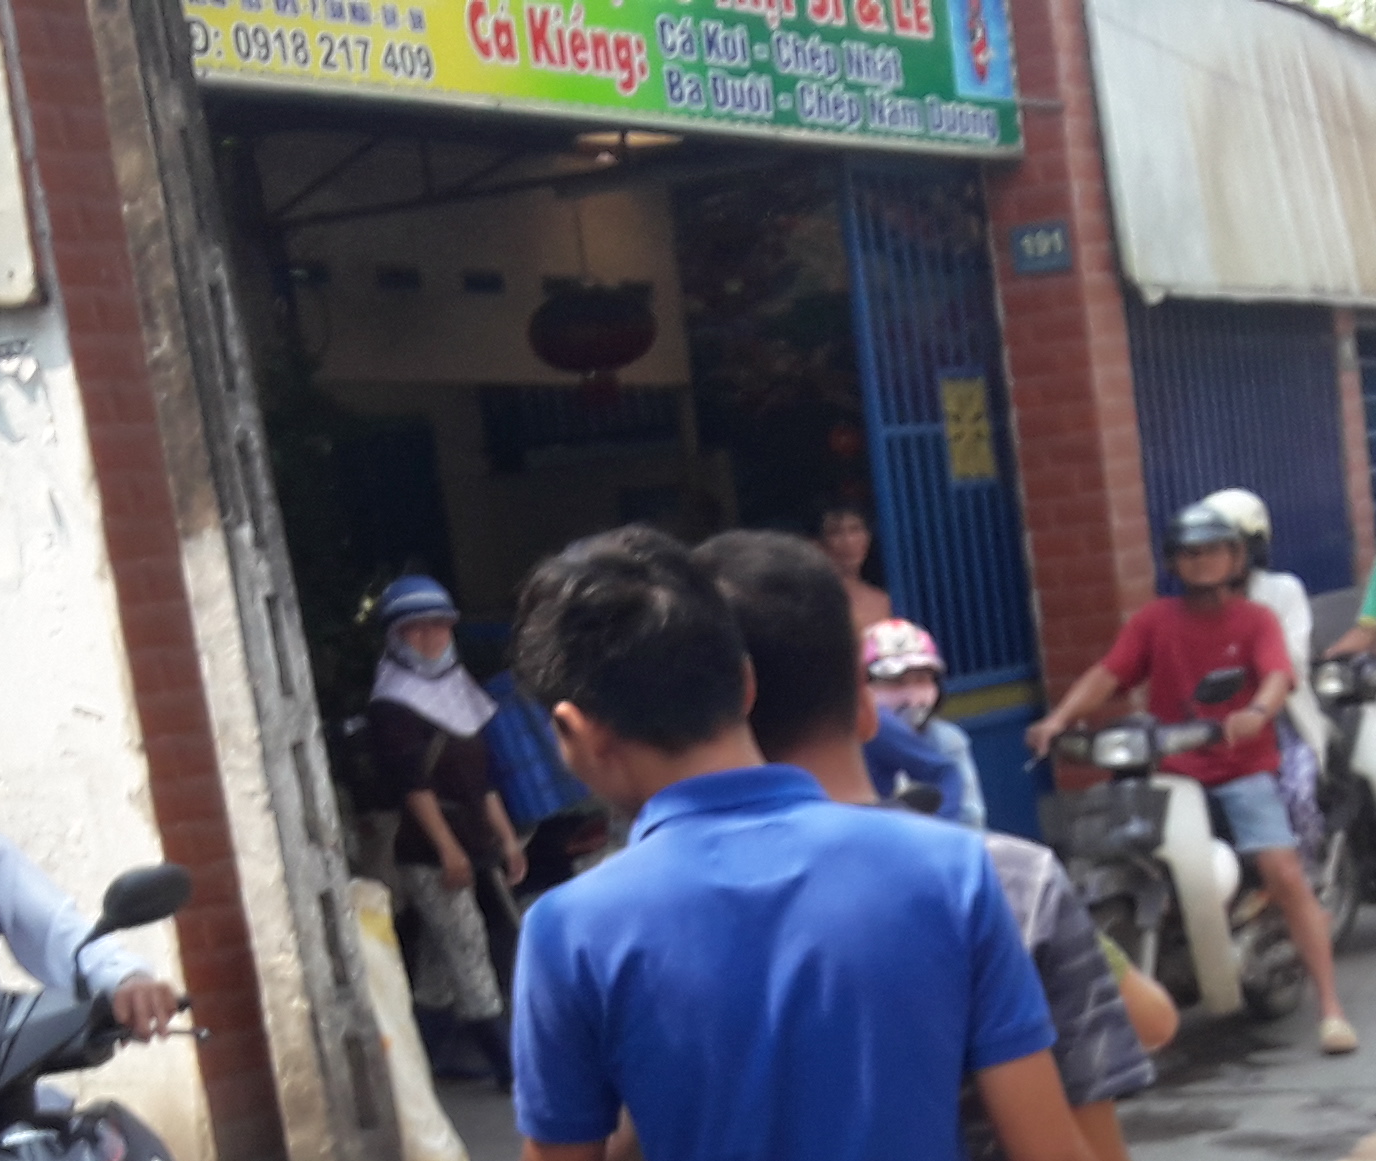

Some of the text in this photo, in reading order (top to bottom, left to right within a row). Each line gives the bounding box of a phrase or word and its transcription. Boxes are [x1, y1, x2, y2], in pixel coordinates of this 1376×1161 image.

[232, 21, 311, 68] 0918
[317, 31, 373, 73] 217
[381, 40, 436, 81] 409
[655, 14, 698, 61] Cá
[662, 63, 707, 110] Ba
